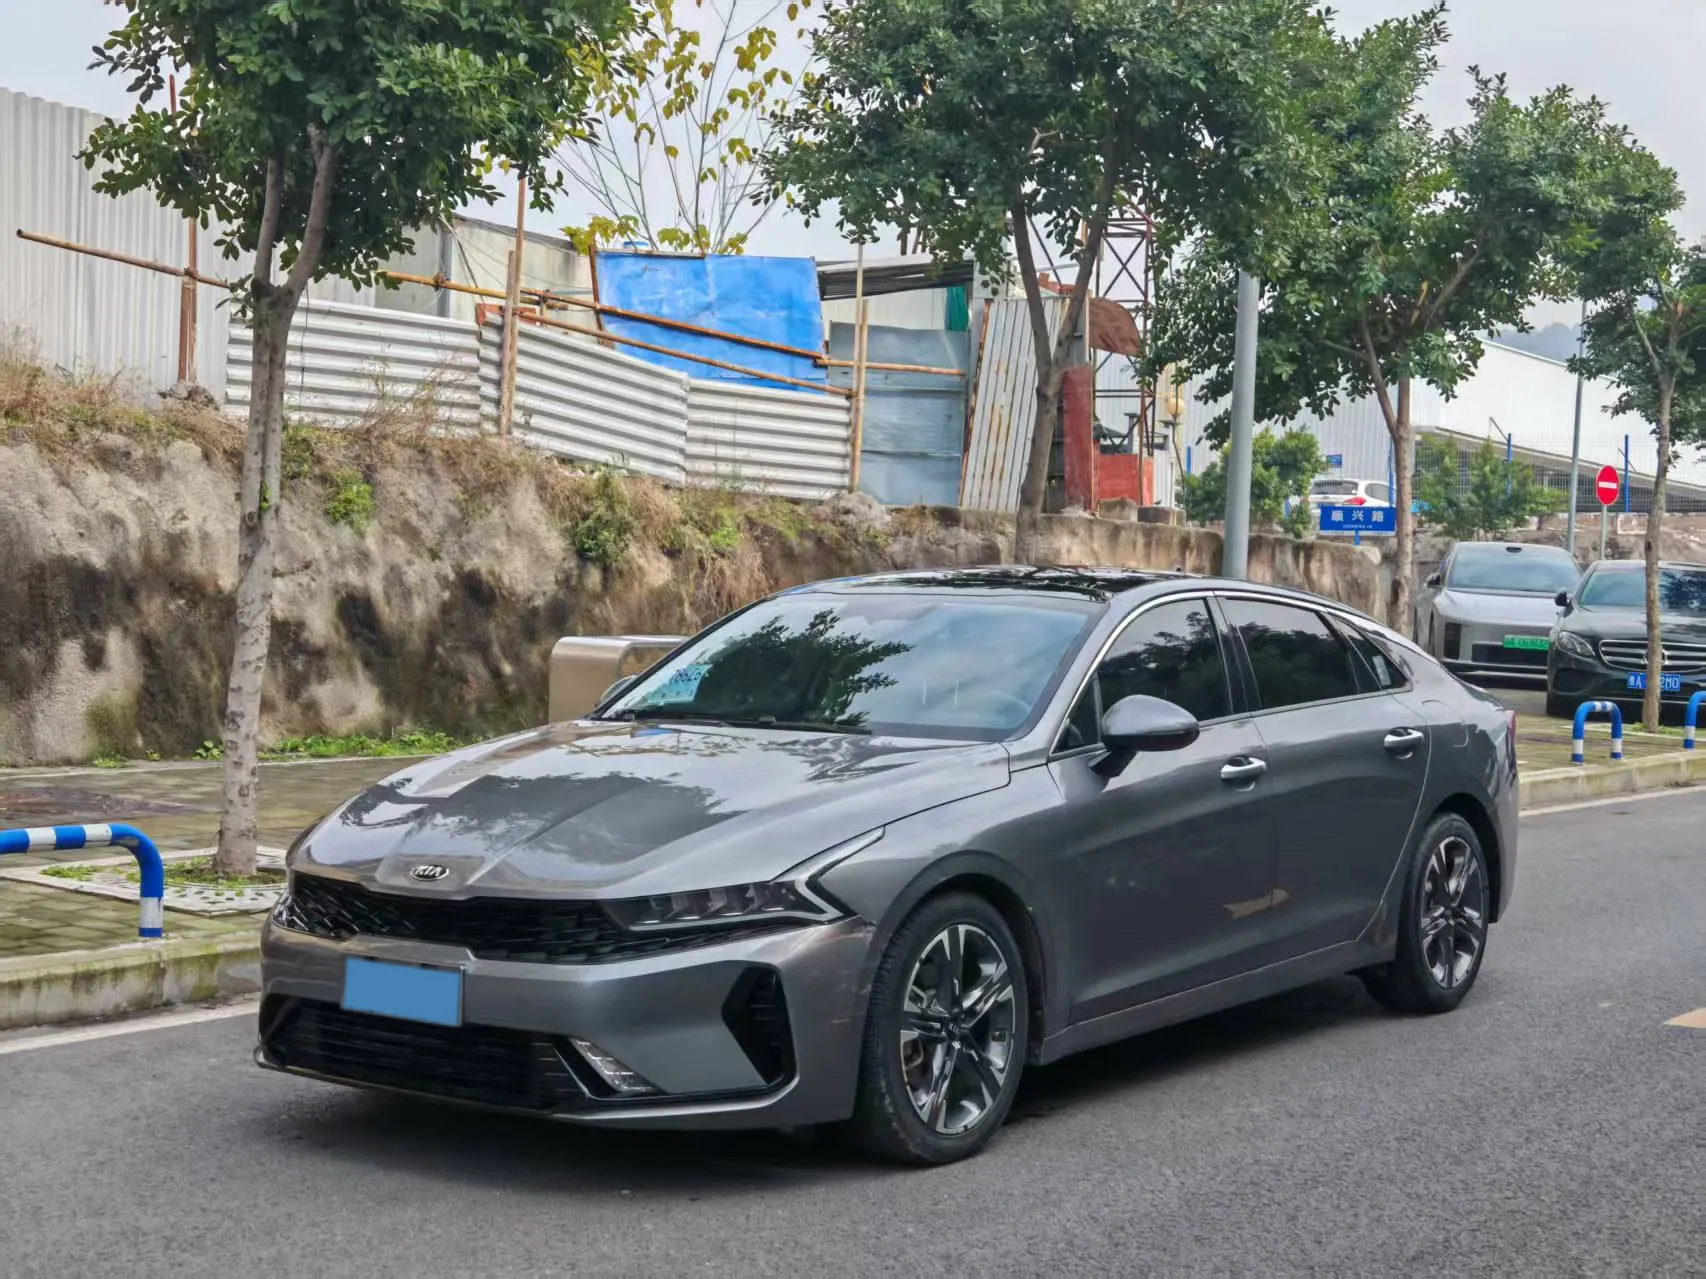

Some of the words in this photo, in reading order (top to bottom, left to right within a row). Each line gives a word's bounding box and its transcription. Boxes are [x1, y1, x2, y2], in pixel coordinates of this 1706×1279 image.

[1331, 510, 1384, 522] 顺兴路
[414, 865, 441, 877] KIA
